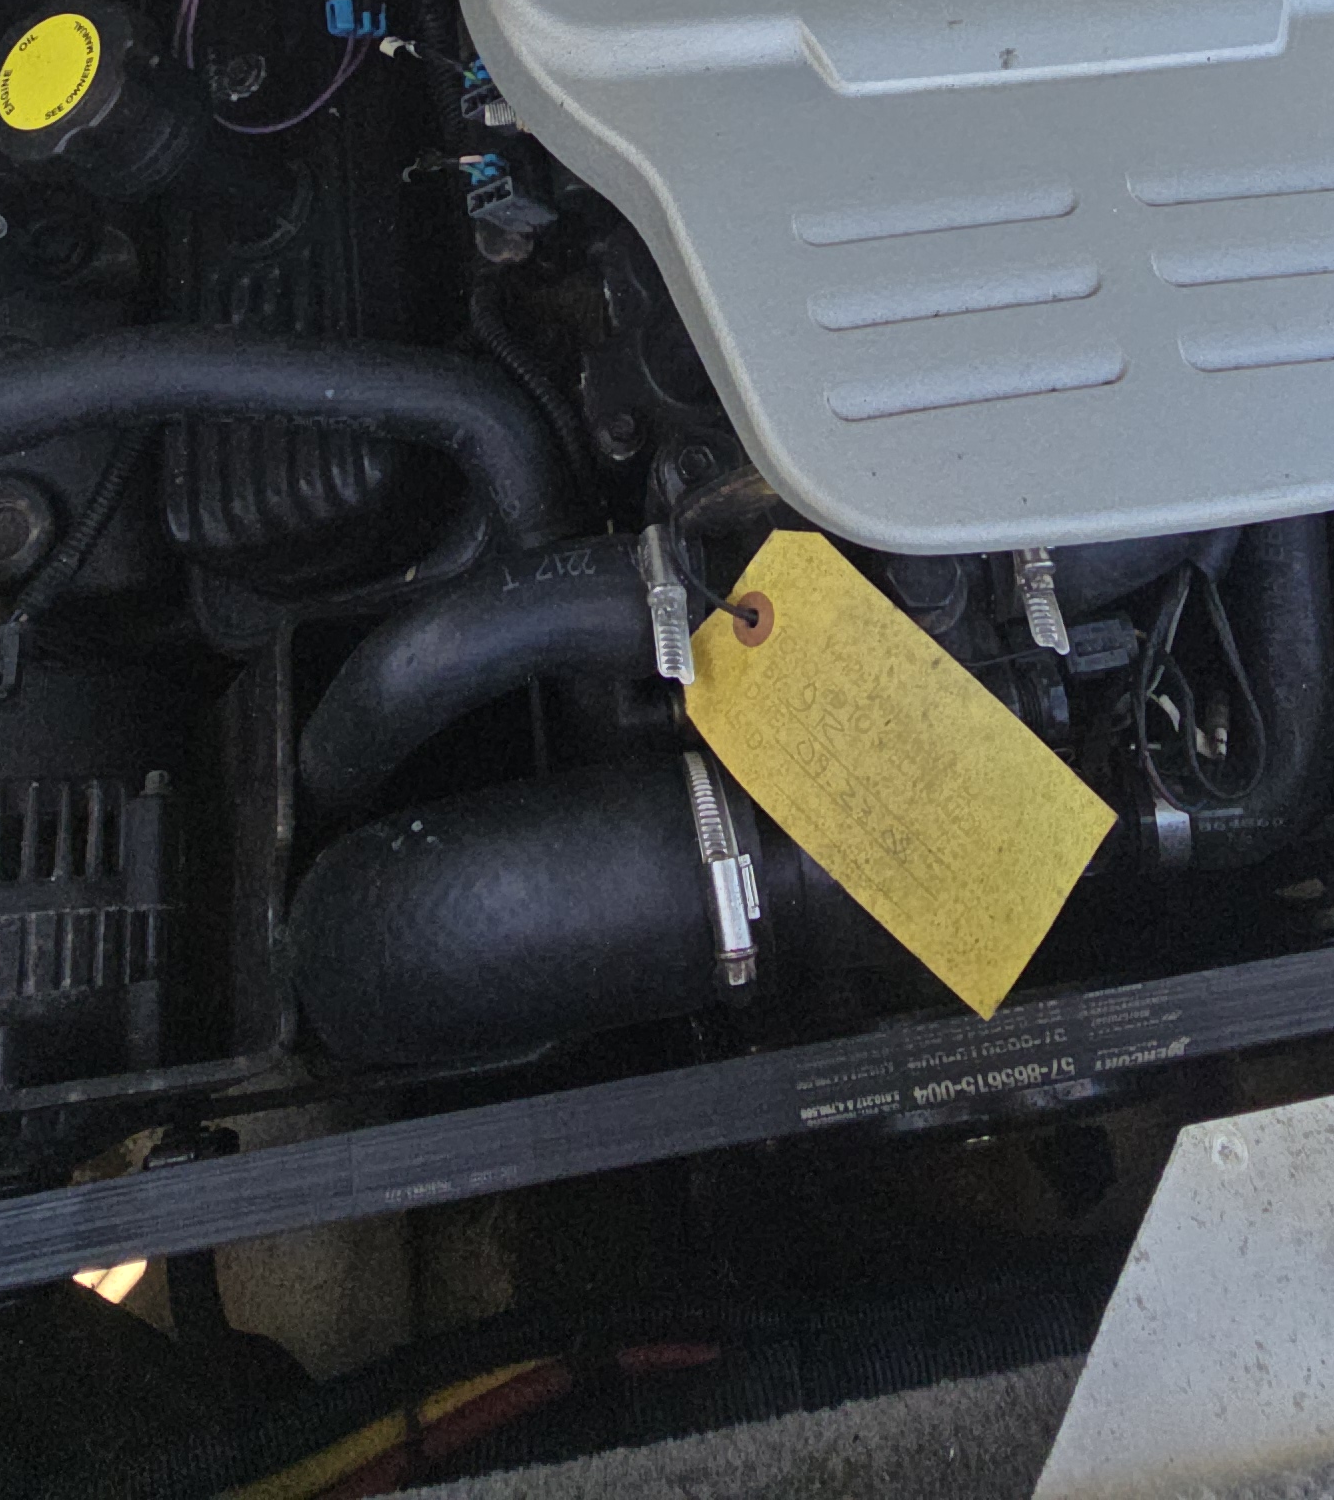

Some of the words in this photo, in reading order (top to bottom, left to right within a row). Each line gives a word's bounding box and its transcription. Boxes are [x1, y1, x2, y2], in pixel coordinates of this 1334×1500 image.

[73, 20, 94, 56] MANUAL
[0, 68, 15, 116] ENGINE
[18, 33, 38, 52] OIL
[65, 56, 94, 105] OWNERS
[44, 102, 65, 121] SEE
[913, 1056, 1076, 1106] 57-865615-004
